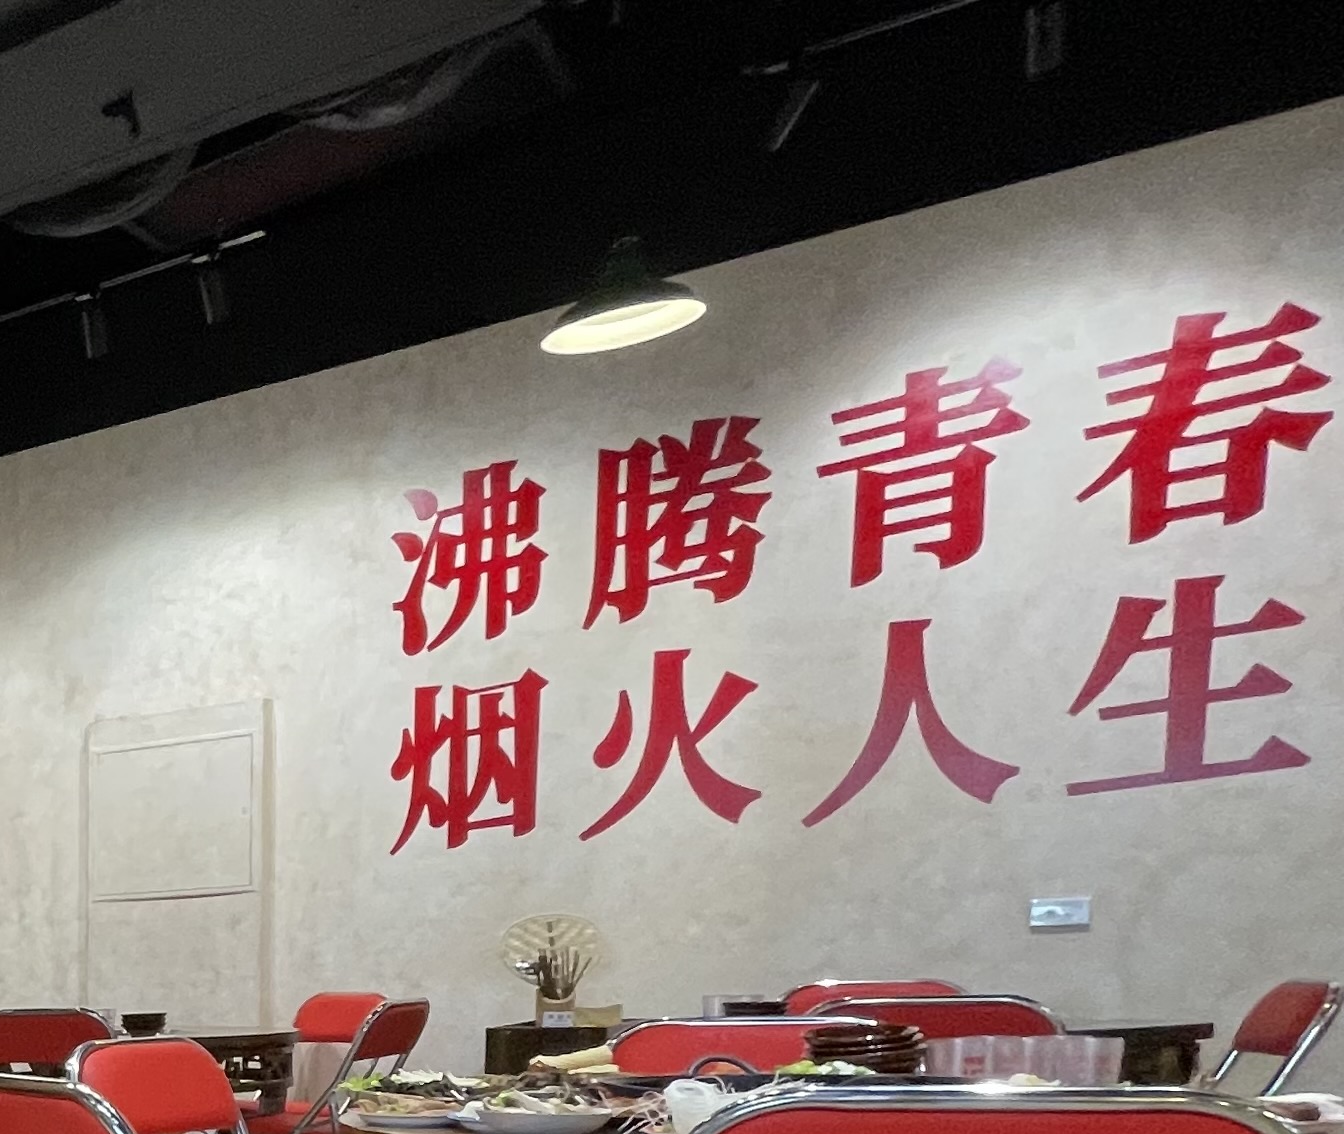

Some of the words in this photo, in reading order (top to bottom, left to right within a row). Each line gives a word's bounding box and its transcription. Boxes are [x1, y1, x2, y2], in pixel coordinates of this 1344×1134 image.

[391, 302, 1334, 657] 沸腾青春
[390, 574, 1312, 857] 烟火人生
